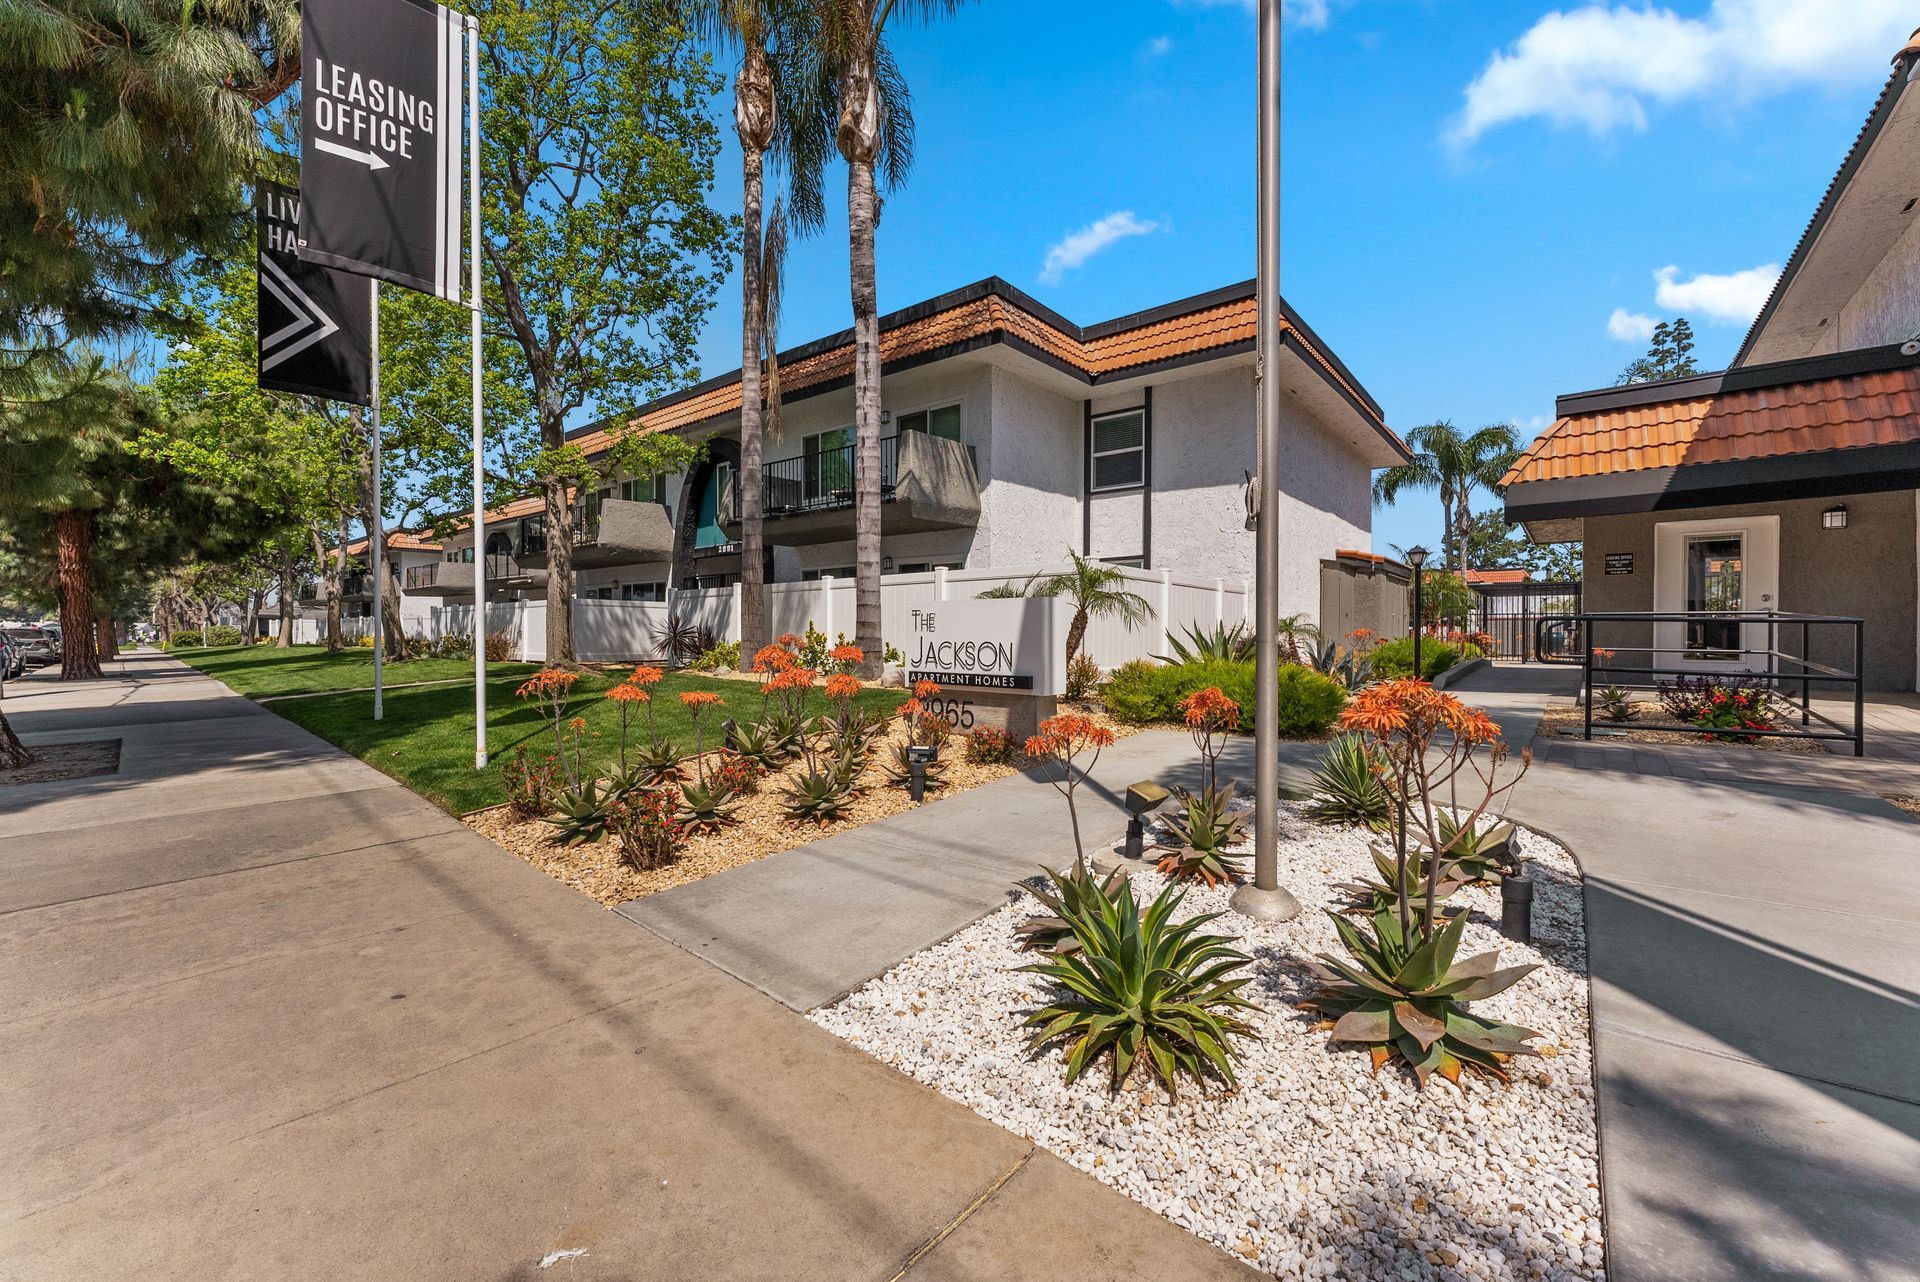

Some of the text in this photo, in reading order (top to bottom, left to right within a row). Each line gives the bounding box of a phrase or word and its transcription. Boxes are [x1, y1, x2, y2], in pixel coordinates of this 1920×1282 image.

[315, 58, 434, 135] LEASING
[315, 96, 413, 160] OFFICE
[911, 609, 936, 632] THE
[910, 636, 1013, 671] JACKSON
[910, 673, 1015, 687] APARTMENT HOMES
